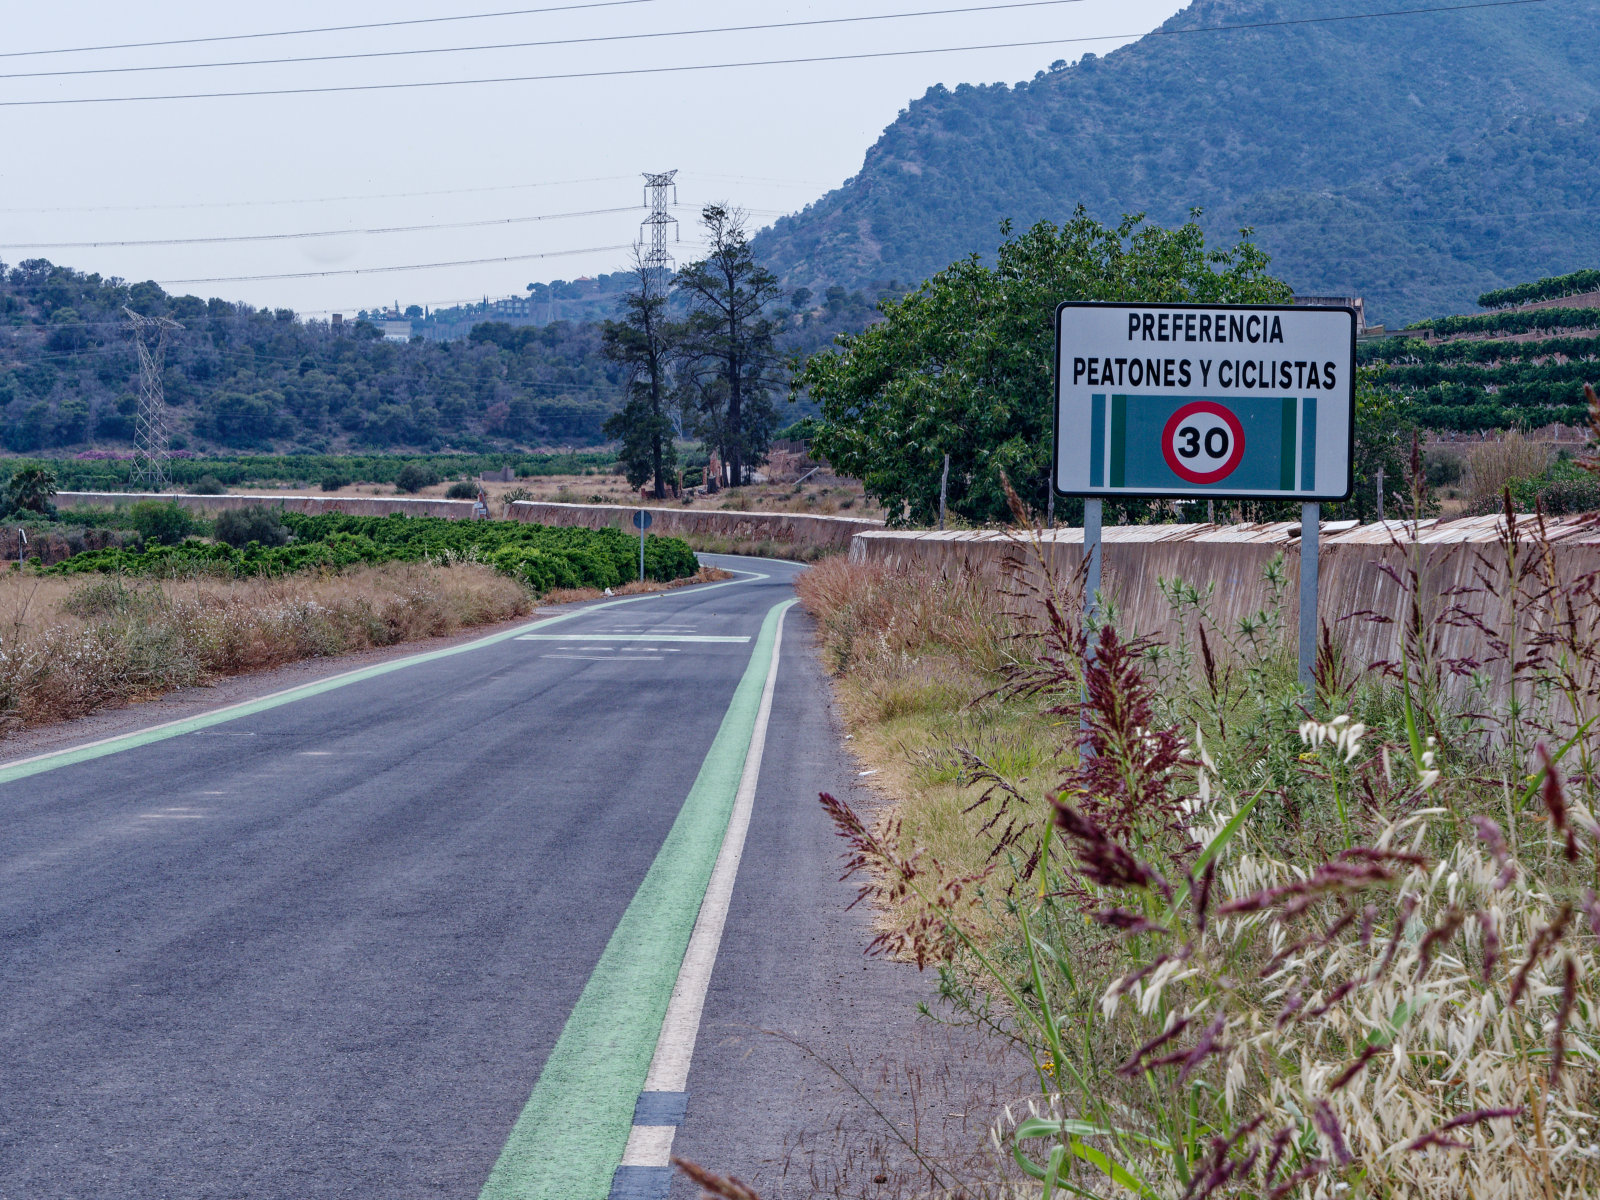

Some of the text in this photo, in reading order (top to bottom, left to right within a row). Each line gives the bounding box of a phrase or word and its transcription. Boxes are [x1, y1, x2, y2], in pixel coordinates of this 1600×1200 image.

[1128, 313, 1284, 343] PREFERENCIA
[1073, 358, 1336, 389] PEATONES Y CICLISTAS
[1178, 427, 1229, 459] 30
